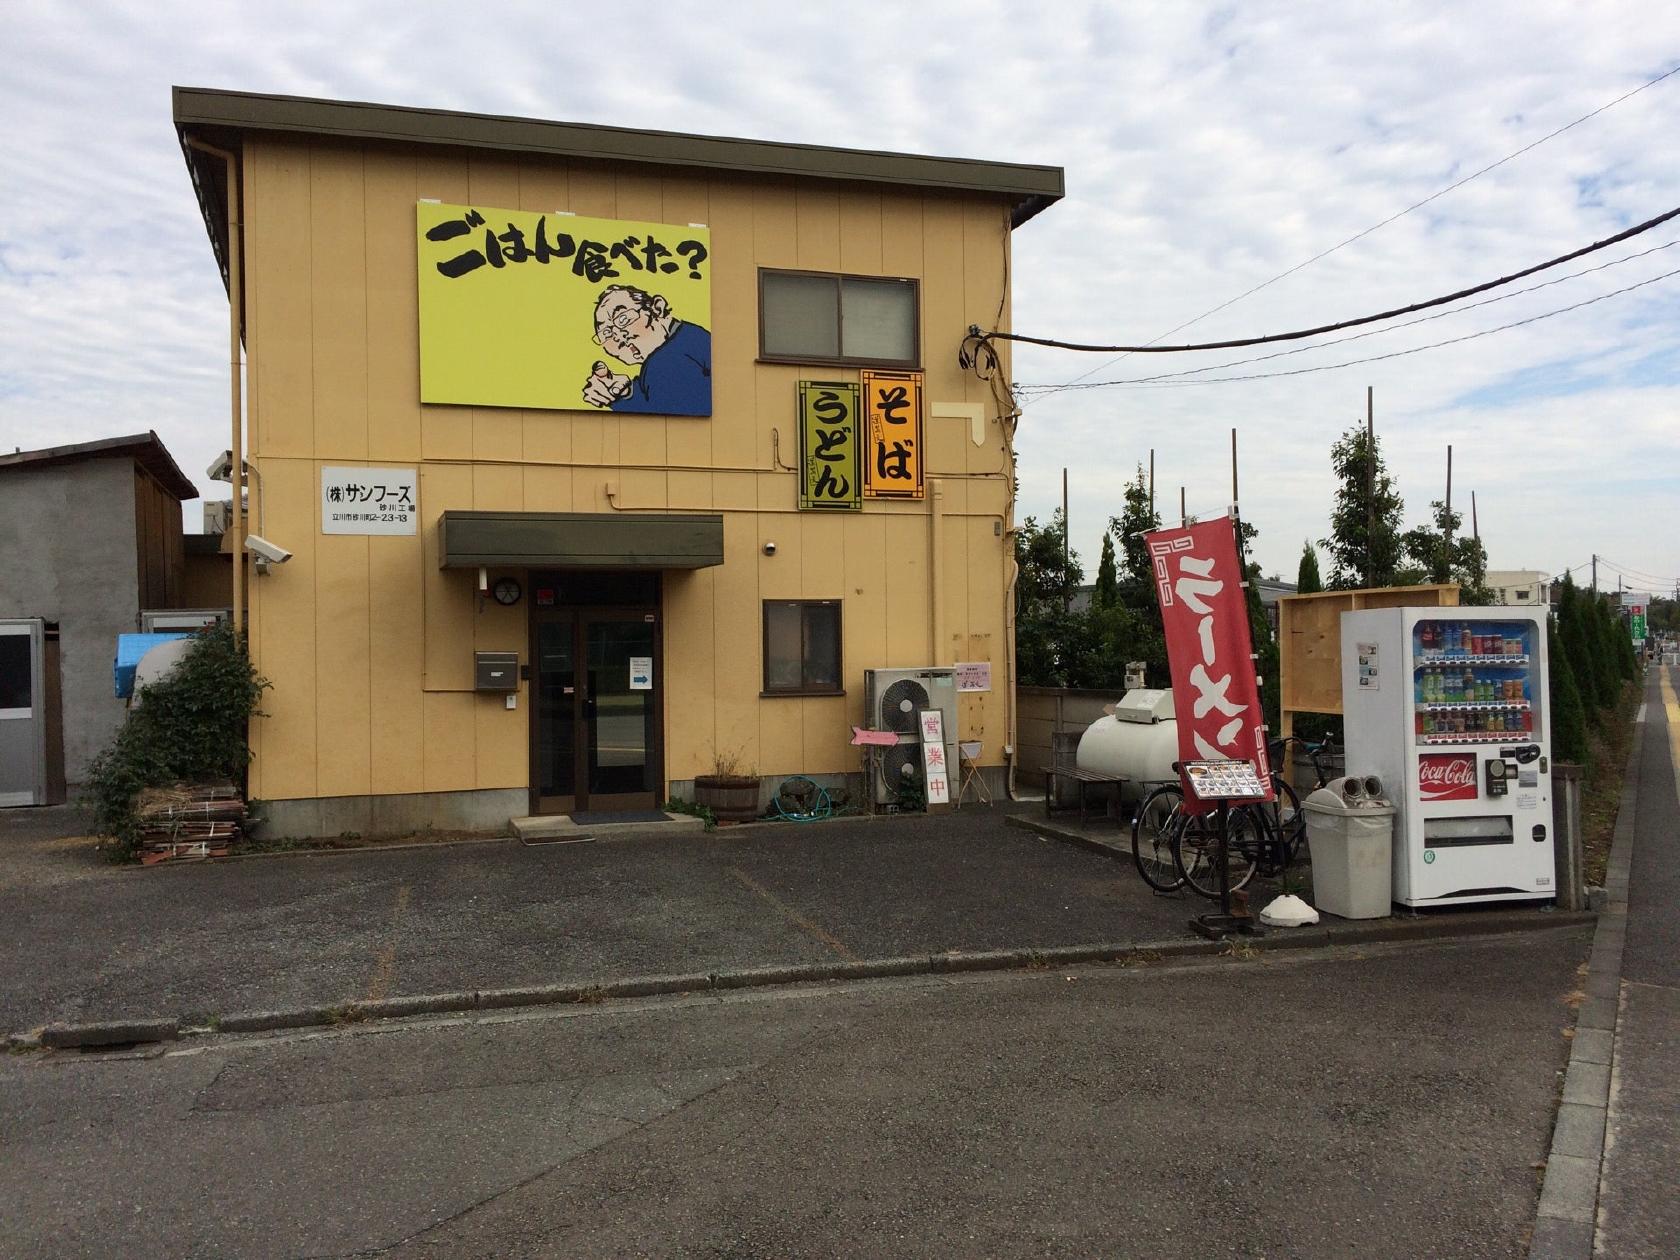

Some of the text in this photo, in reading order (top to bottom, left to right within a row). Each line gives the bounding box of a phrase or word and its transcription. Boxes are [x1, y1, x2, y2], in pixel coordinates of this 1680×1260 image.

[426, 209, 708, 283] ごはん食べた?
[813, 391, 852, 498] うどん
[876, 386, 914, 480] そば
[326, 484, 411, 503] (株)サンフーズ
[924, 716, 945, 797] 営業中
